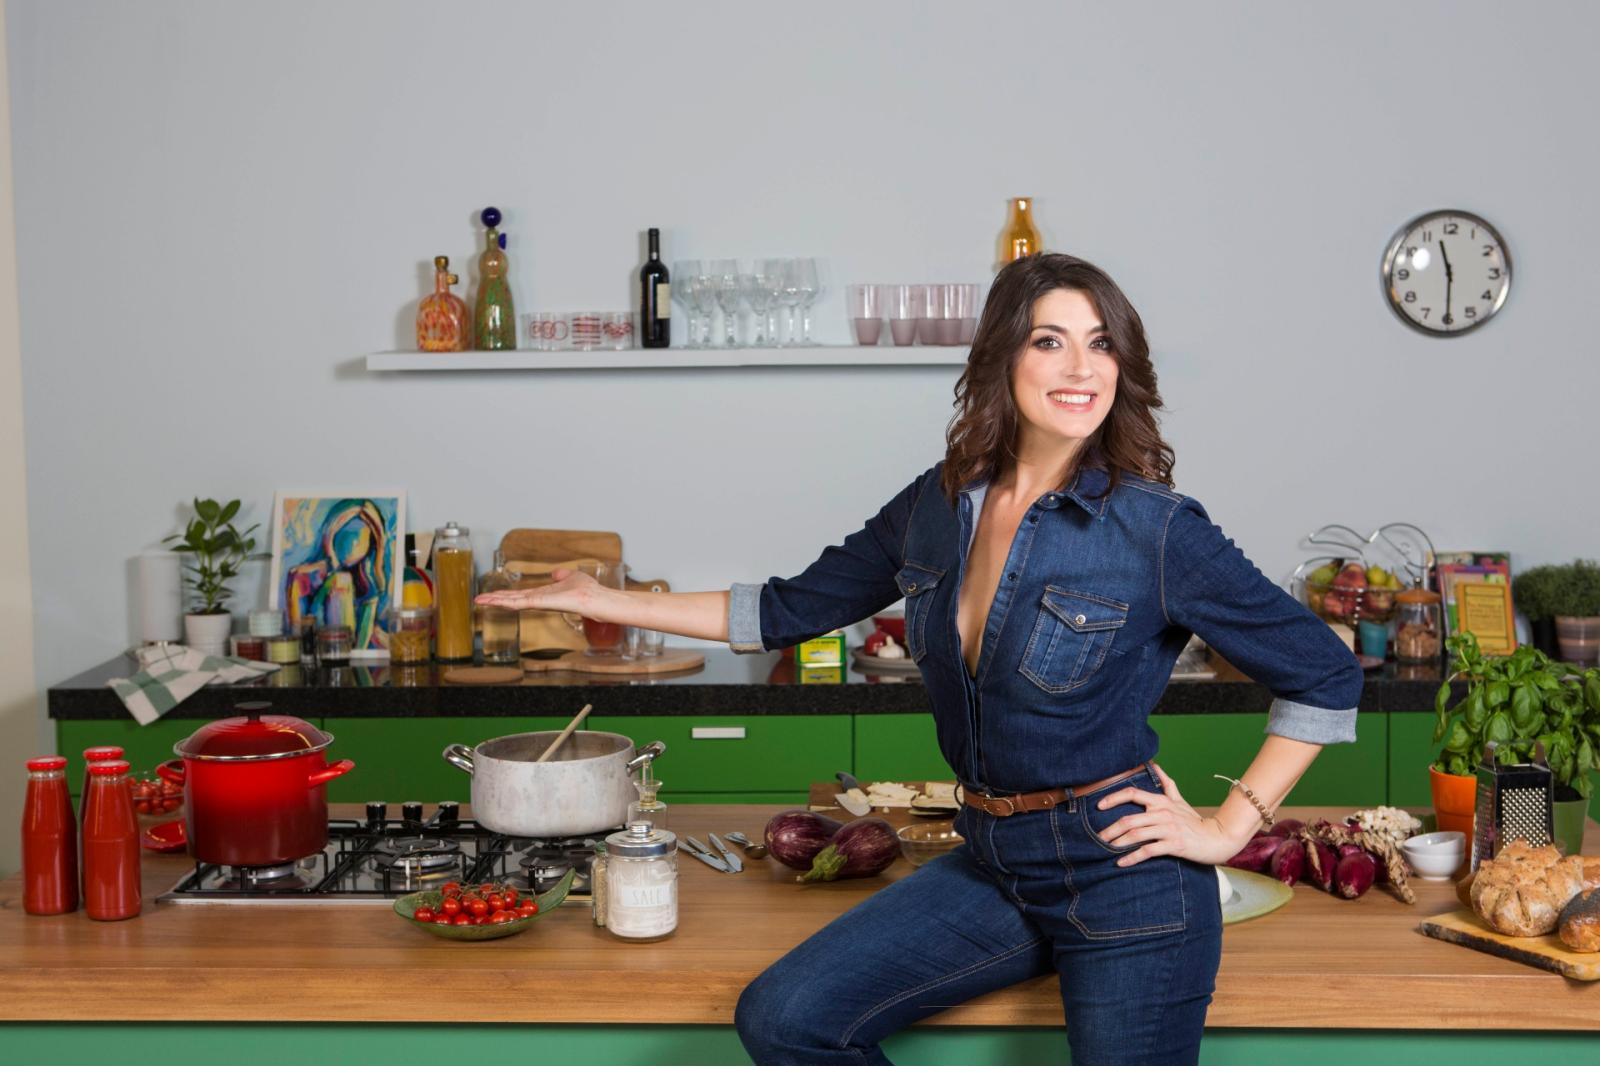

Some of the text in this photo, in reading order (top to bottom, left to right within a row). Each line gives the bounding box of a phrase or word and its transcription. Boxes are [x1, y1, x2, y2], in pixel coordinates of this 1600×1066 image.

[1443, 223, 1459, 235] 12
[1470, 228, 1475, 240] 1
[1422, 231, 1432, 242] 11
[1482, 245, 1494, 257] 2
[1398, 269, 1409, 280] 9
[1488, 268, 1500, 280] 3
[1404, 291, 1417, 303] 8
[1481, 290, 1492, 300] 4
[1420, 307, 1431, 319] 7
[1464, 306, 1477, 318] 5
